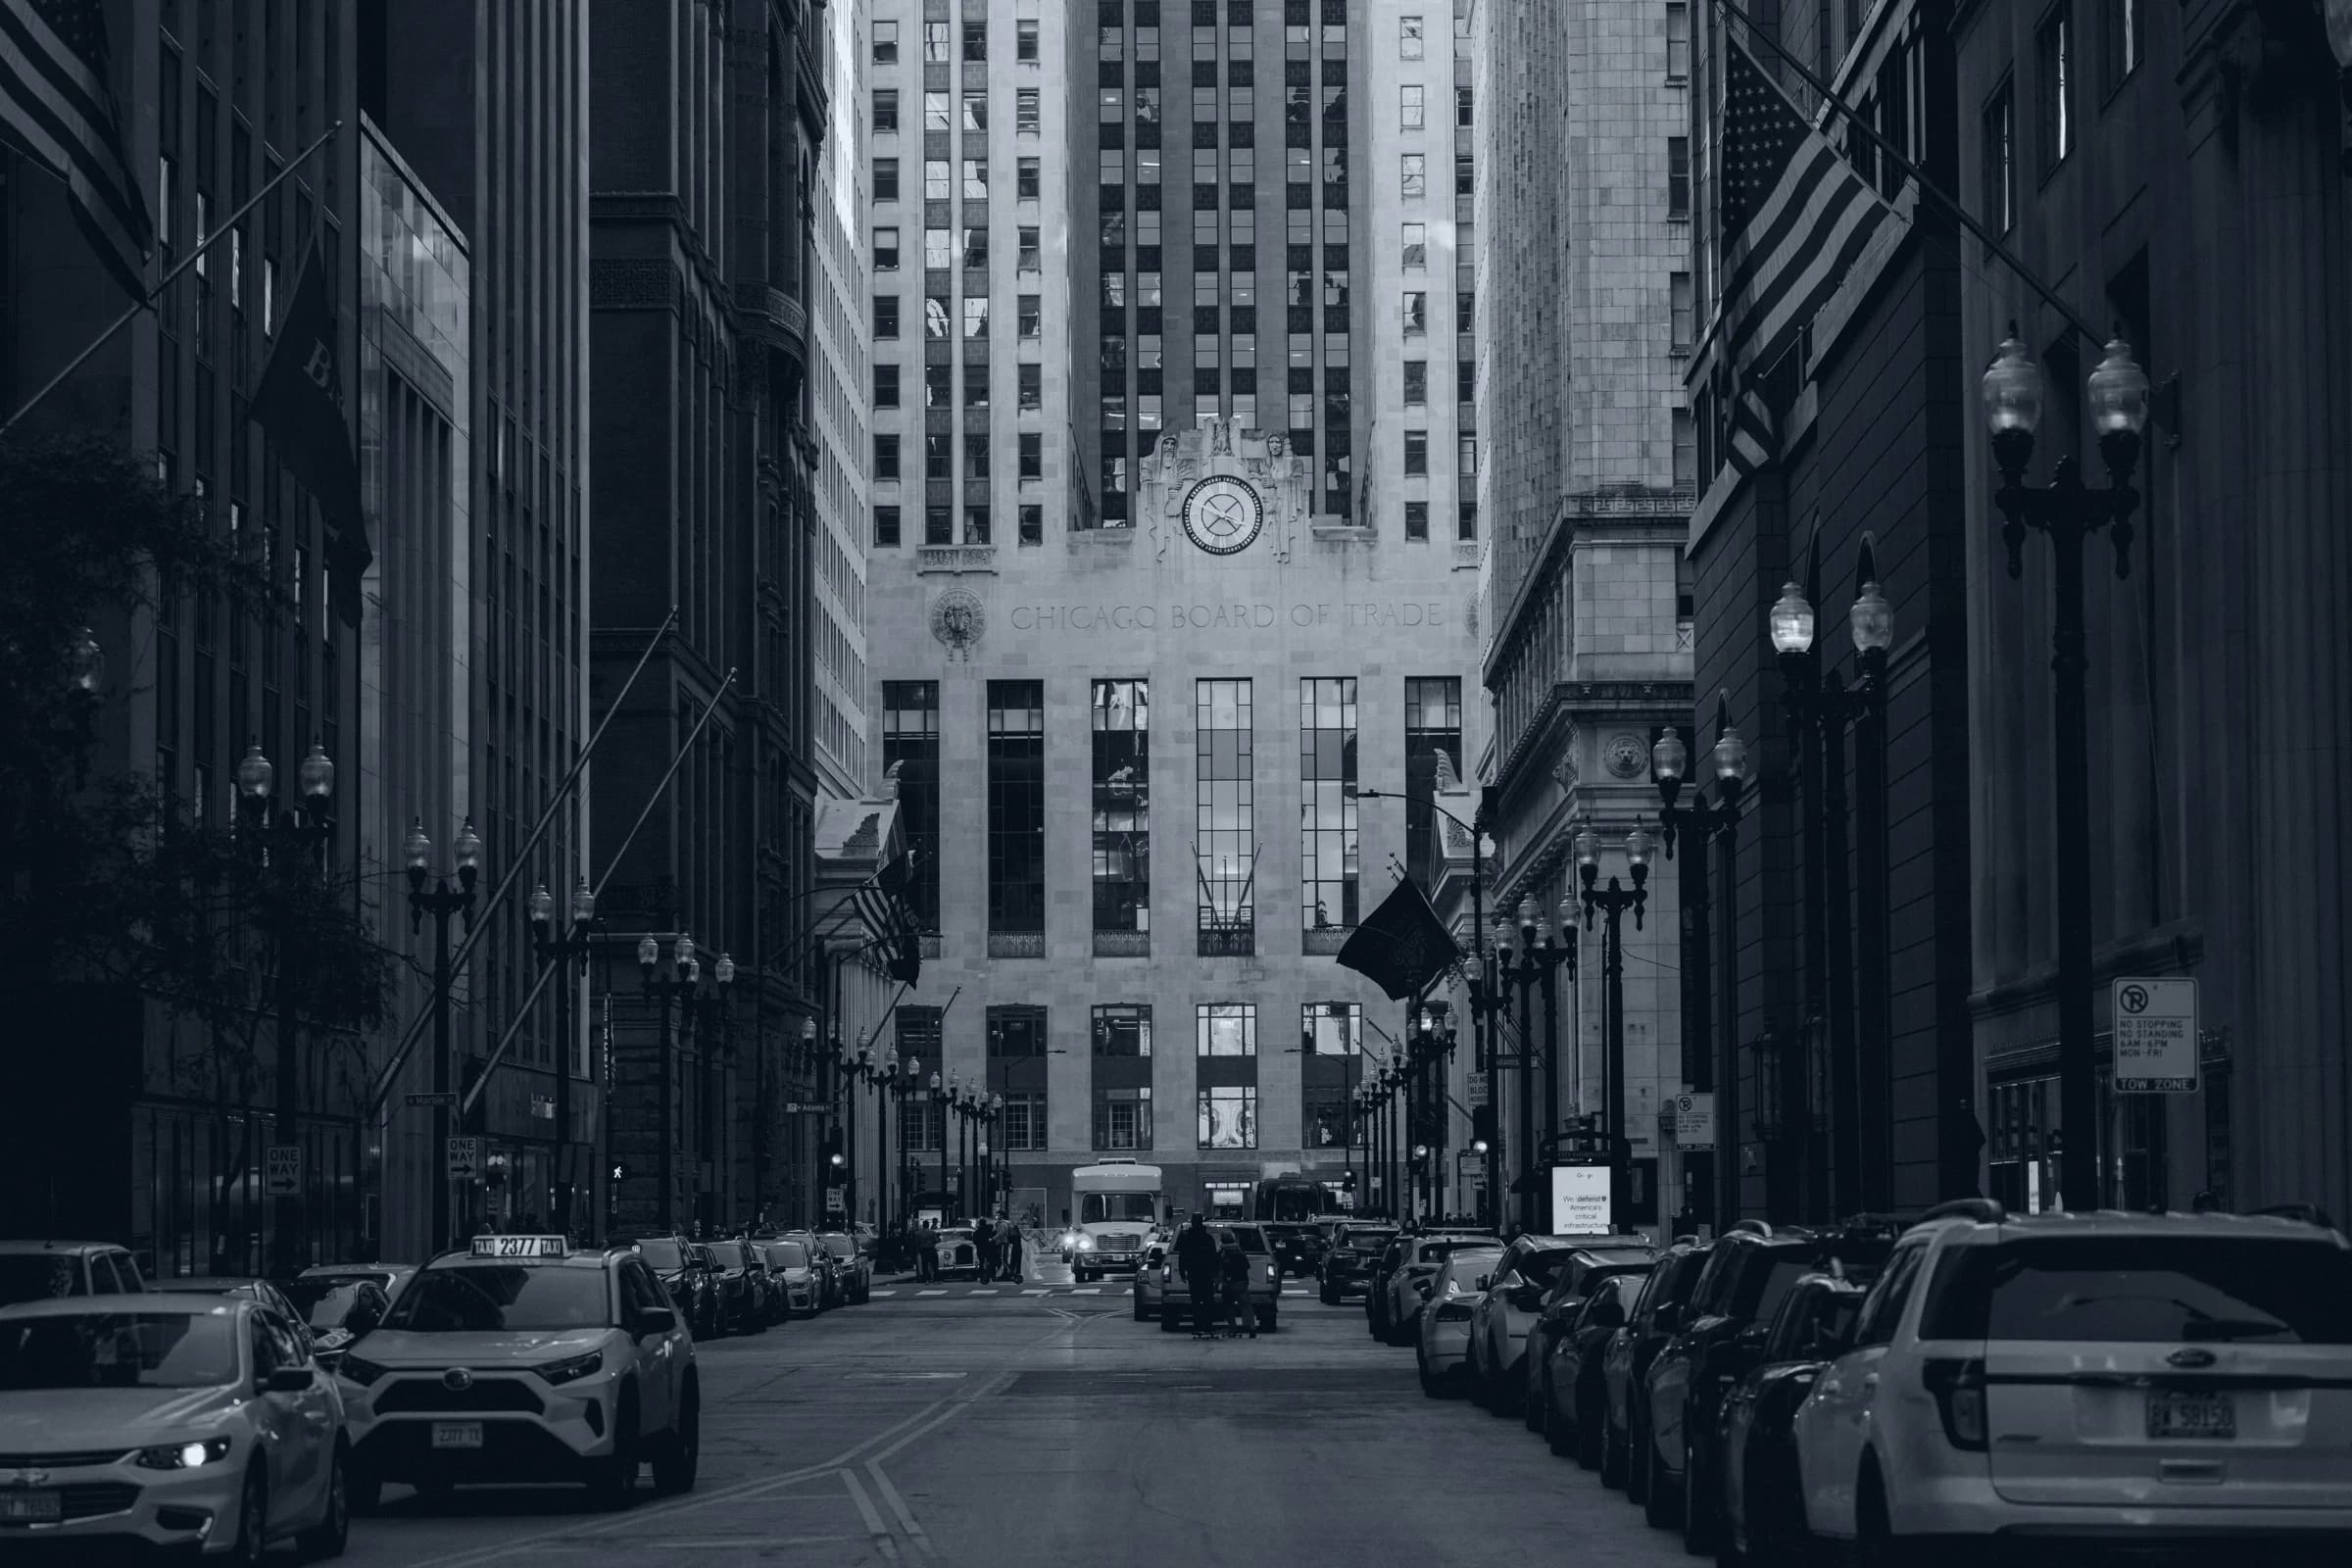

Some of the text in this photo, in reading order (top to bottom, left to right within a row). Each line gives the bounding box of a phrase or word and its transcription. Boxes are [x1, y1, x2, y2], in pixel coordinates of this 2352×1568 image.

[1010, 603, 1444, 630] CHICAGO BOARD OF TRADE
[2137, 1030, 2183, 1039] STANDING
[2120, 1078, 2189, 1090] TOW ZONE
[450, 1140, 474, 1151] ONE
[270, 1149, 299, 1161] ONE
[449, 1152, 474, 1161] WAY
[270, 1163, 298, 1176] WAY
[1577, 1194, 1601, 1202] defend
[474, 1238, 562, 1255] TAXI 2377 TAXI
